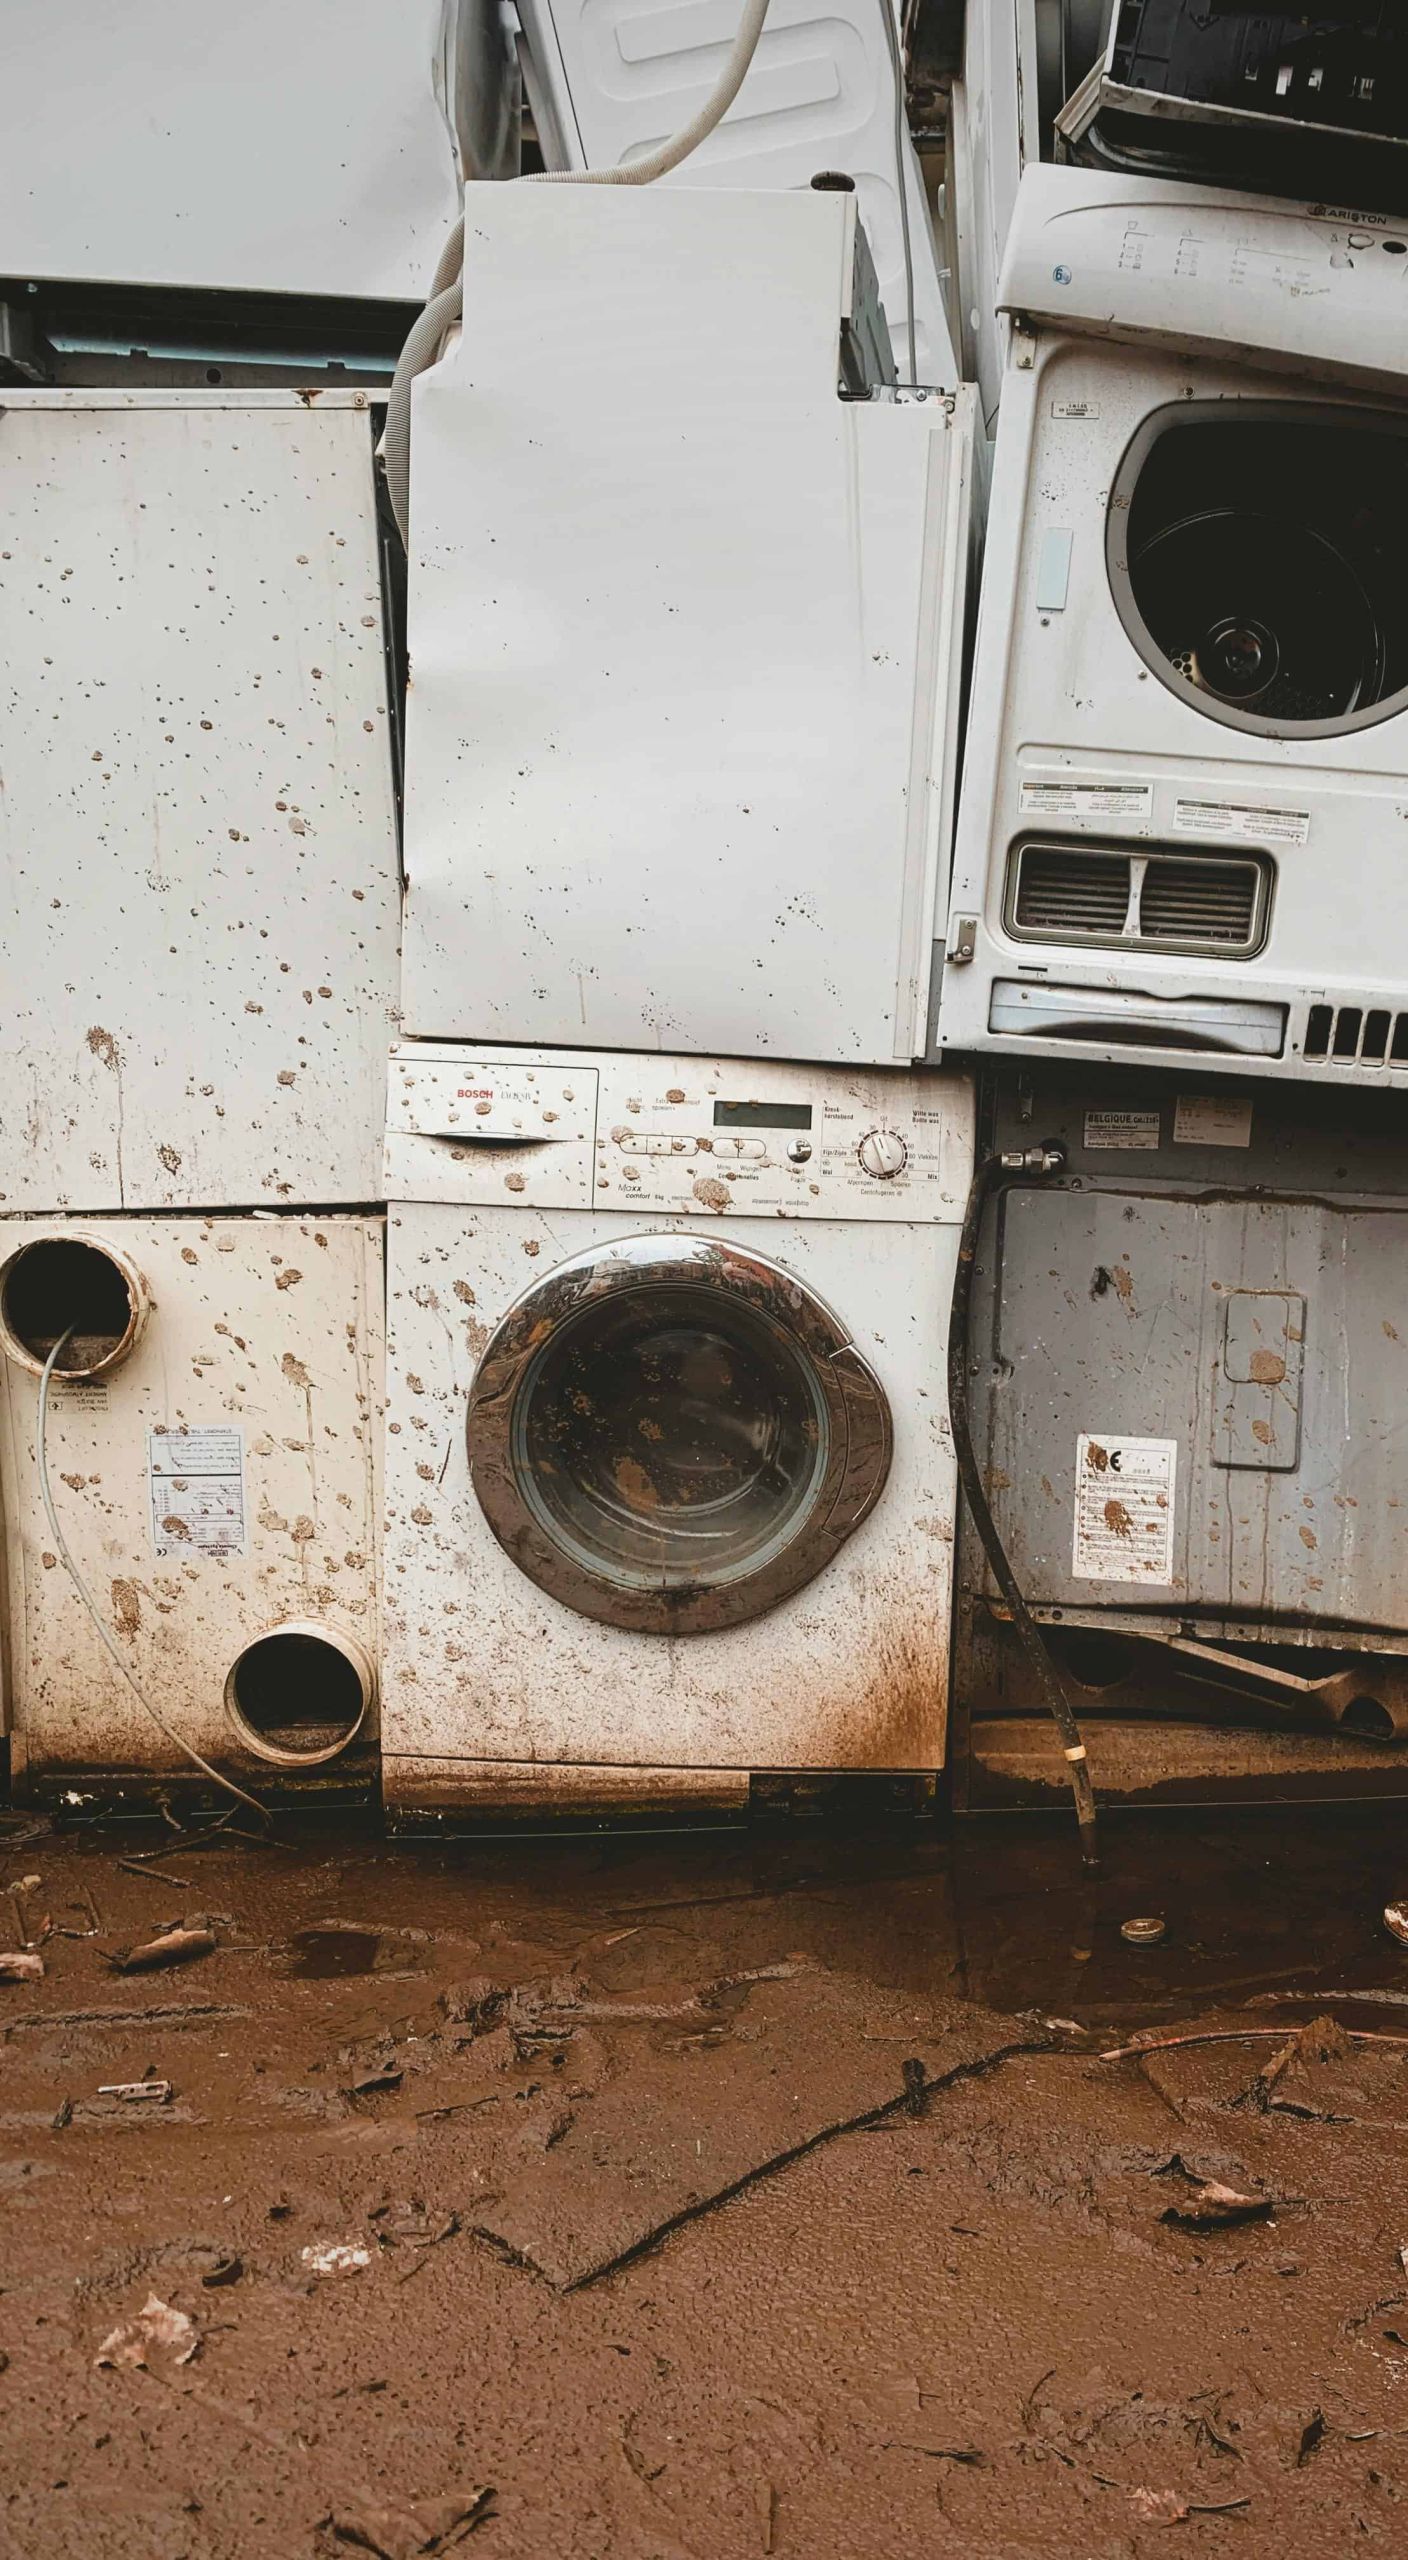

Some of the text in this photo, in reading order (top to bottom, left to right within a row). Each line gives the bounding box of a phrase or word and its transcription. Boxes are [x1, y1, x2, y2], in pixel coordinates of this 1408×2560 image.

[1328, 209, 1387, 225] ARISTON
[457, 1089, 494, 1099] BOSCH
[1088, 1114, 1131, 1123] BELGIQUE
[618, 1184, 642, 1192] Maxx
